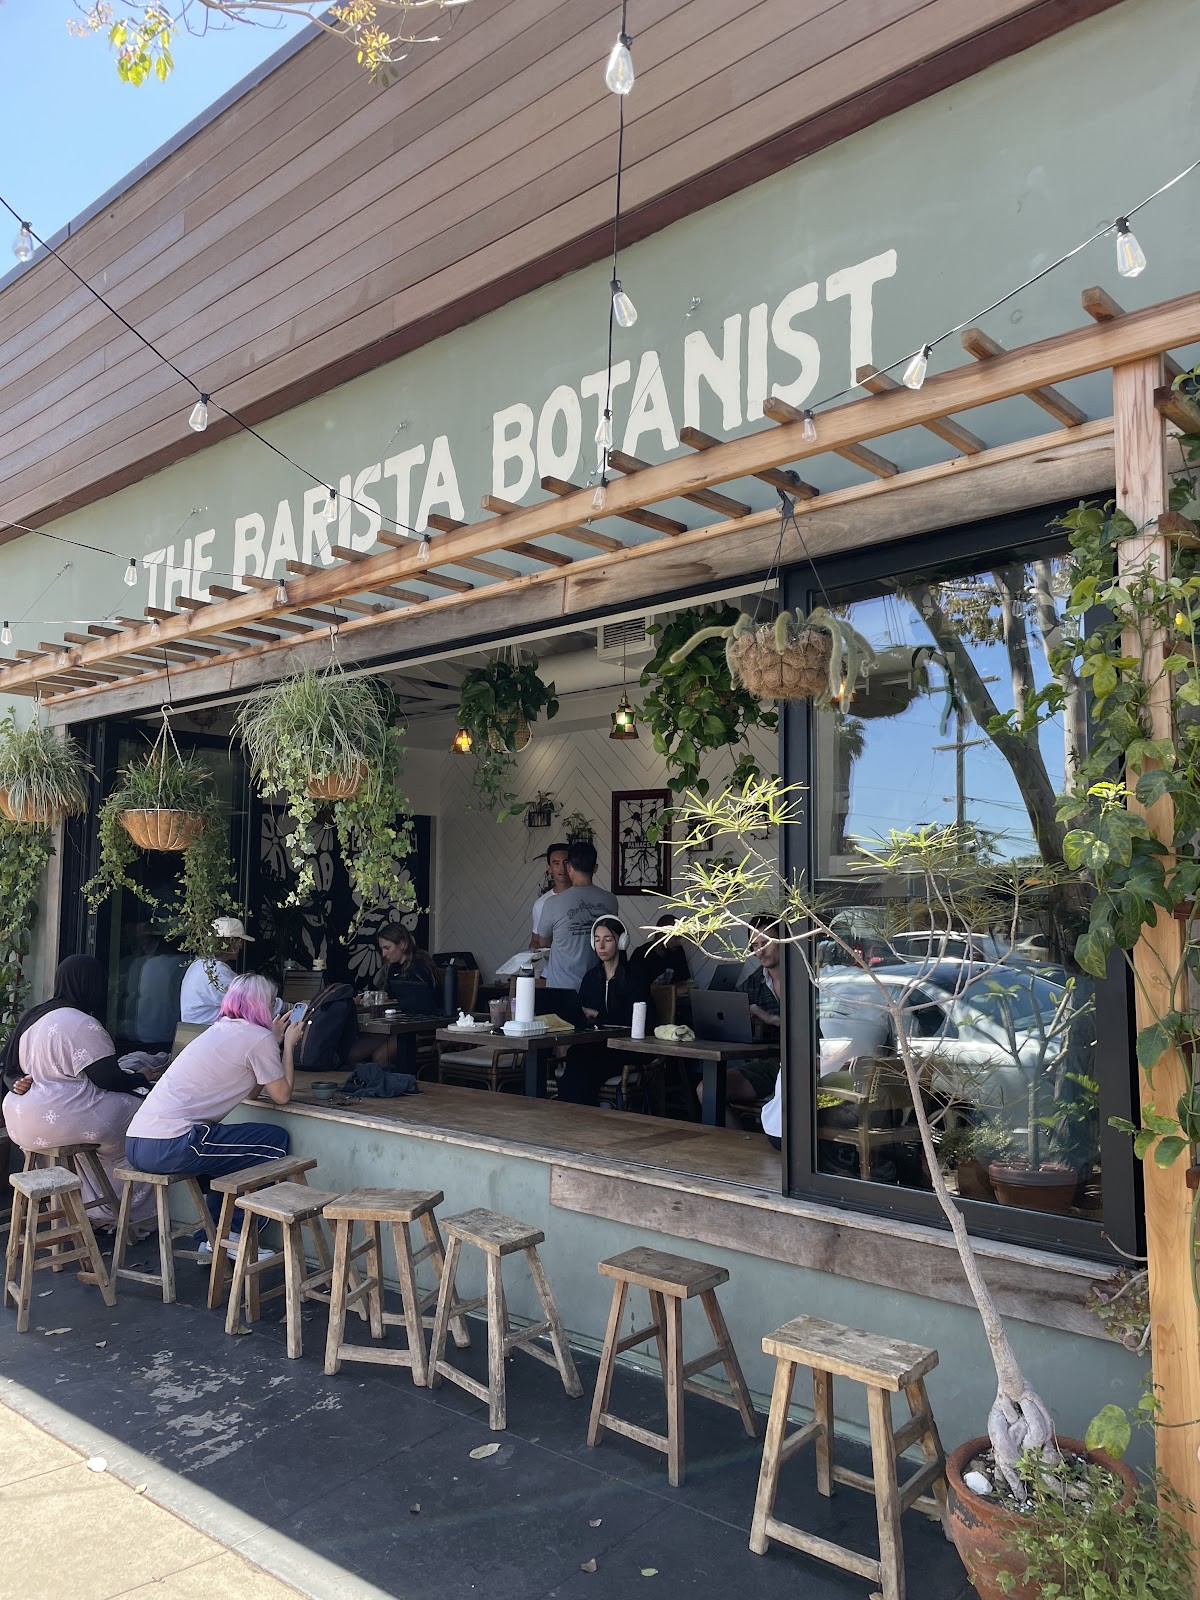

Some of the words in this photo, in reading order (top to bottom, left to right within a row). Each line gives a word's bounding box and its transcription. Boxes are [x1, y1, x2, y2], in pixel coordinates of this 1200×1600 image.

[142, 528, 216, 621] THE
[232, 434, 465, 592] BARISTA
[492, 248, 898, 504] BOTANIST
